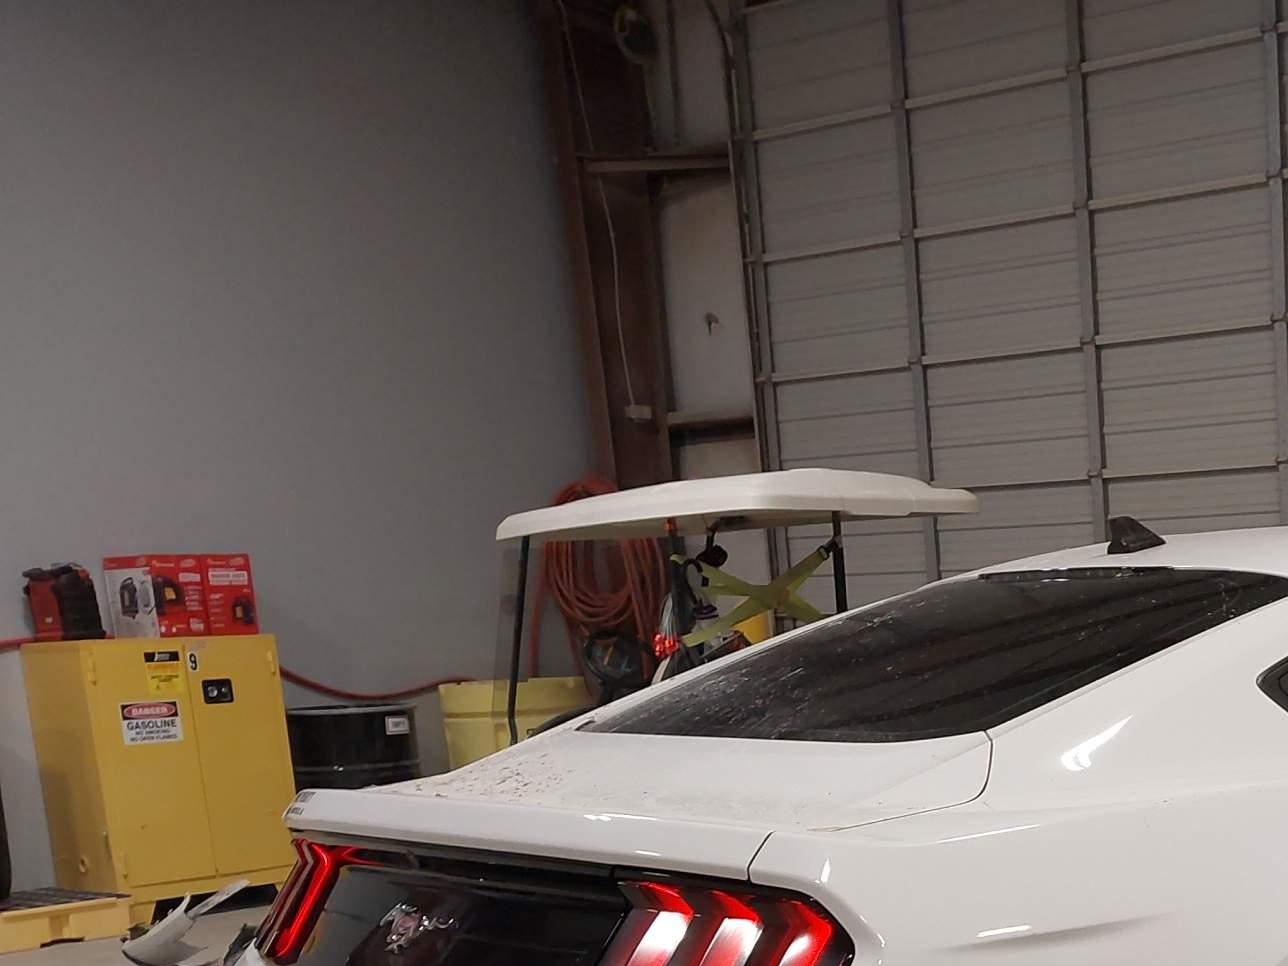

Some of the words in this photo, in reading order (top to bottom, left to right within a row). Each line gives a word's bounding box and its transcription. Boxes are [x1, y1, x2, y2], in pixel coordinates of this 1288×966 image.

[189, 653, 197, 671] 9
[131, 706, 168, 716] DANGER
[126, 719, 177, 731] GASOLINE
